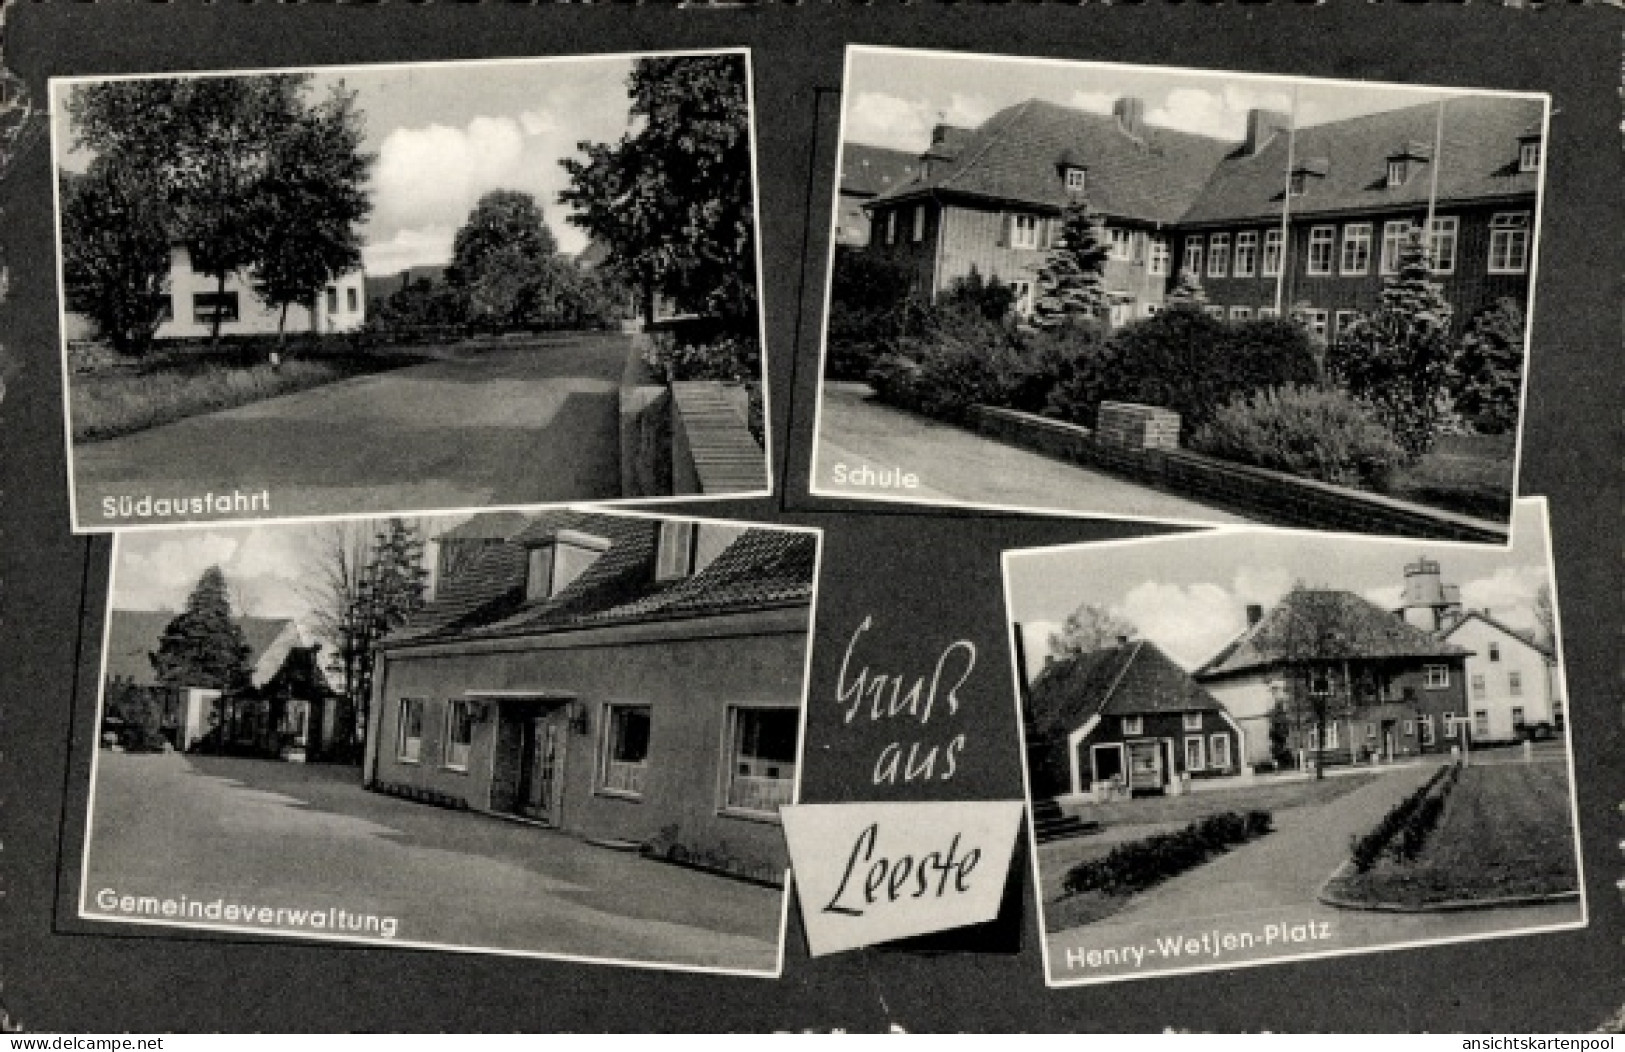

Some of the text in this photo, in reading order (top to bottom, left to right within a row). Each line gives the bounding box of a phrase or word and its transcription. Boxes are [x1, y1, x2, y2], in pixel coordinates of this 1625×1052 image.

[836, 615, 976, 724] Gruß
[873, 735, 965, 785] aus
[821, 822, 981, 915] Leeste
